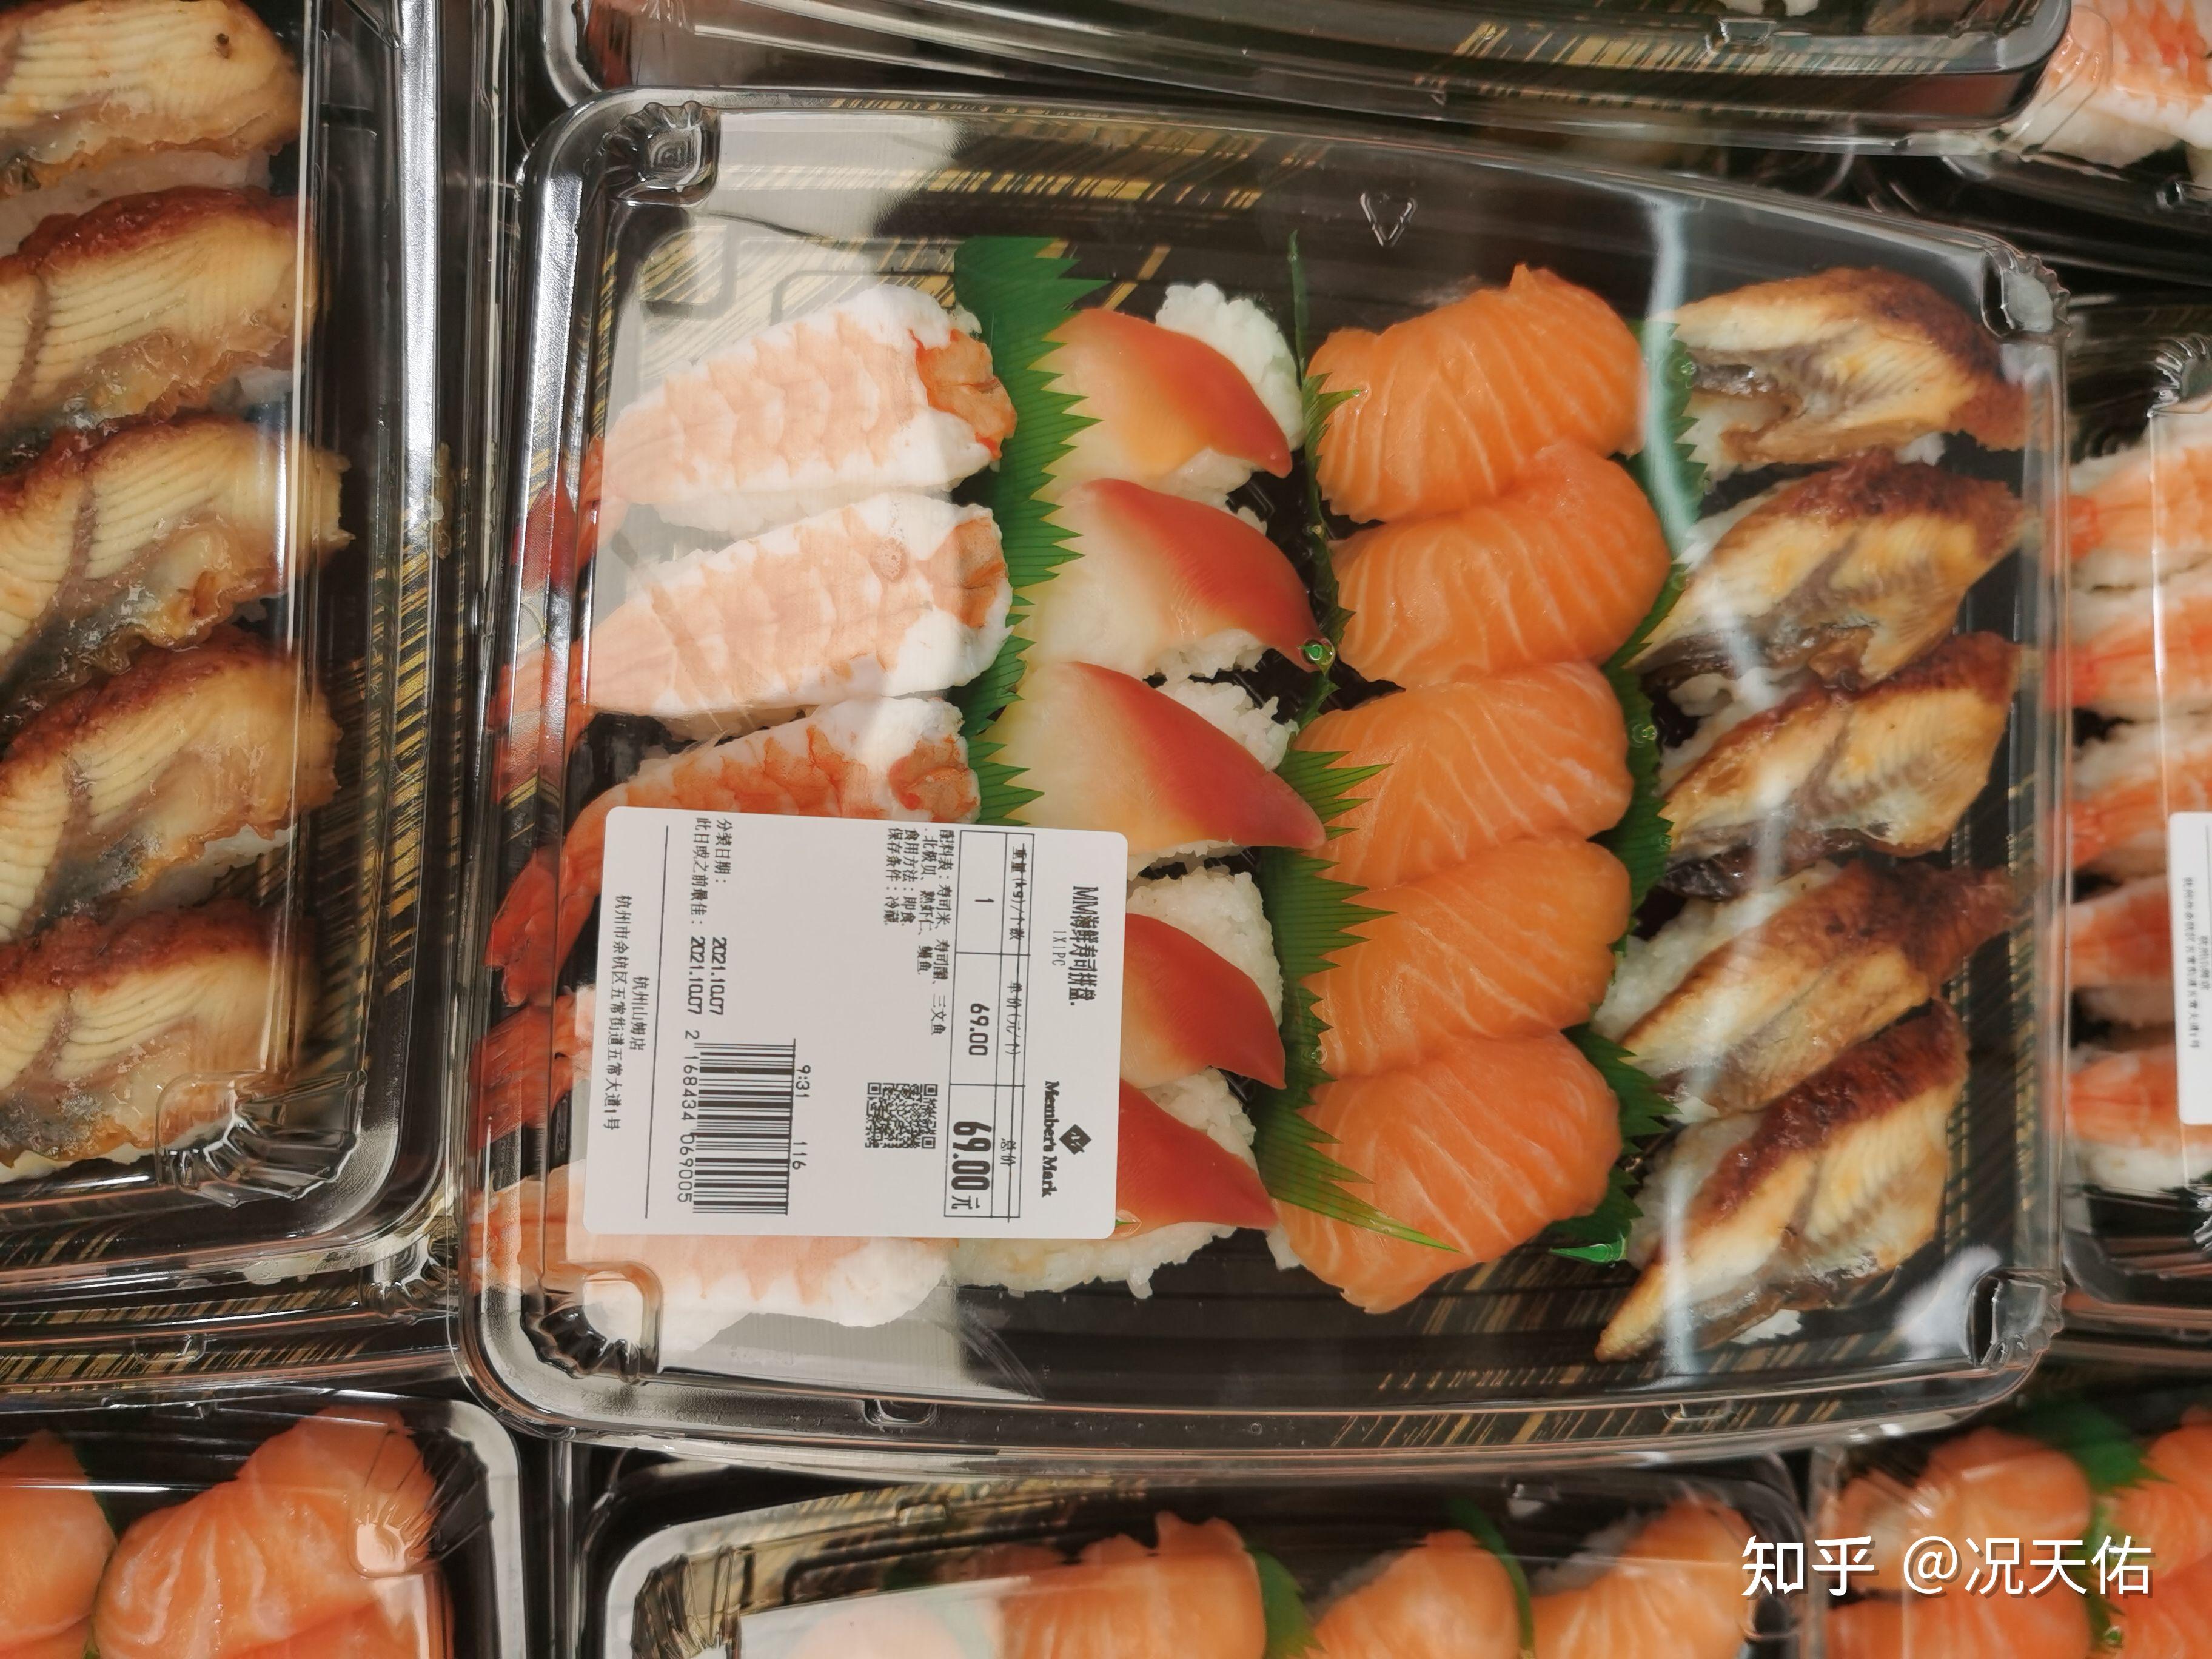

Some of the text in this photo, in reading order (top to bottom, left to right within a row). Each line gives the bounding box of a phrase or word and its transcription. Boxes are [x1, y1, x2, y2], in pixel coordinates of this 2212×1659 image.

[687, 935, 706, 1016] 2021.10.07
[709, 936, 728, 1016] 2021.10.07
[1051, 930, 1067, 967] 1X1PC
[603, 894, 633, 1131] 杭州市余杭区五常街道五常大道1号
[629, 976, 650, 1051] 杭州山姆店
[968, 1002, 990, 1057] 69.00
[677, 1029, 700, 1203] 2 168434 069005
[795, 1064, 811, 1098] 9:31
[792, 1141, 808, 1171] 116
[1000, 1136, 1017, 1169] 总价
[1041, 1079, 1060, 1199] Member's Mark
